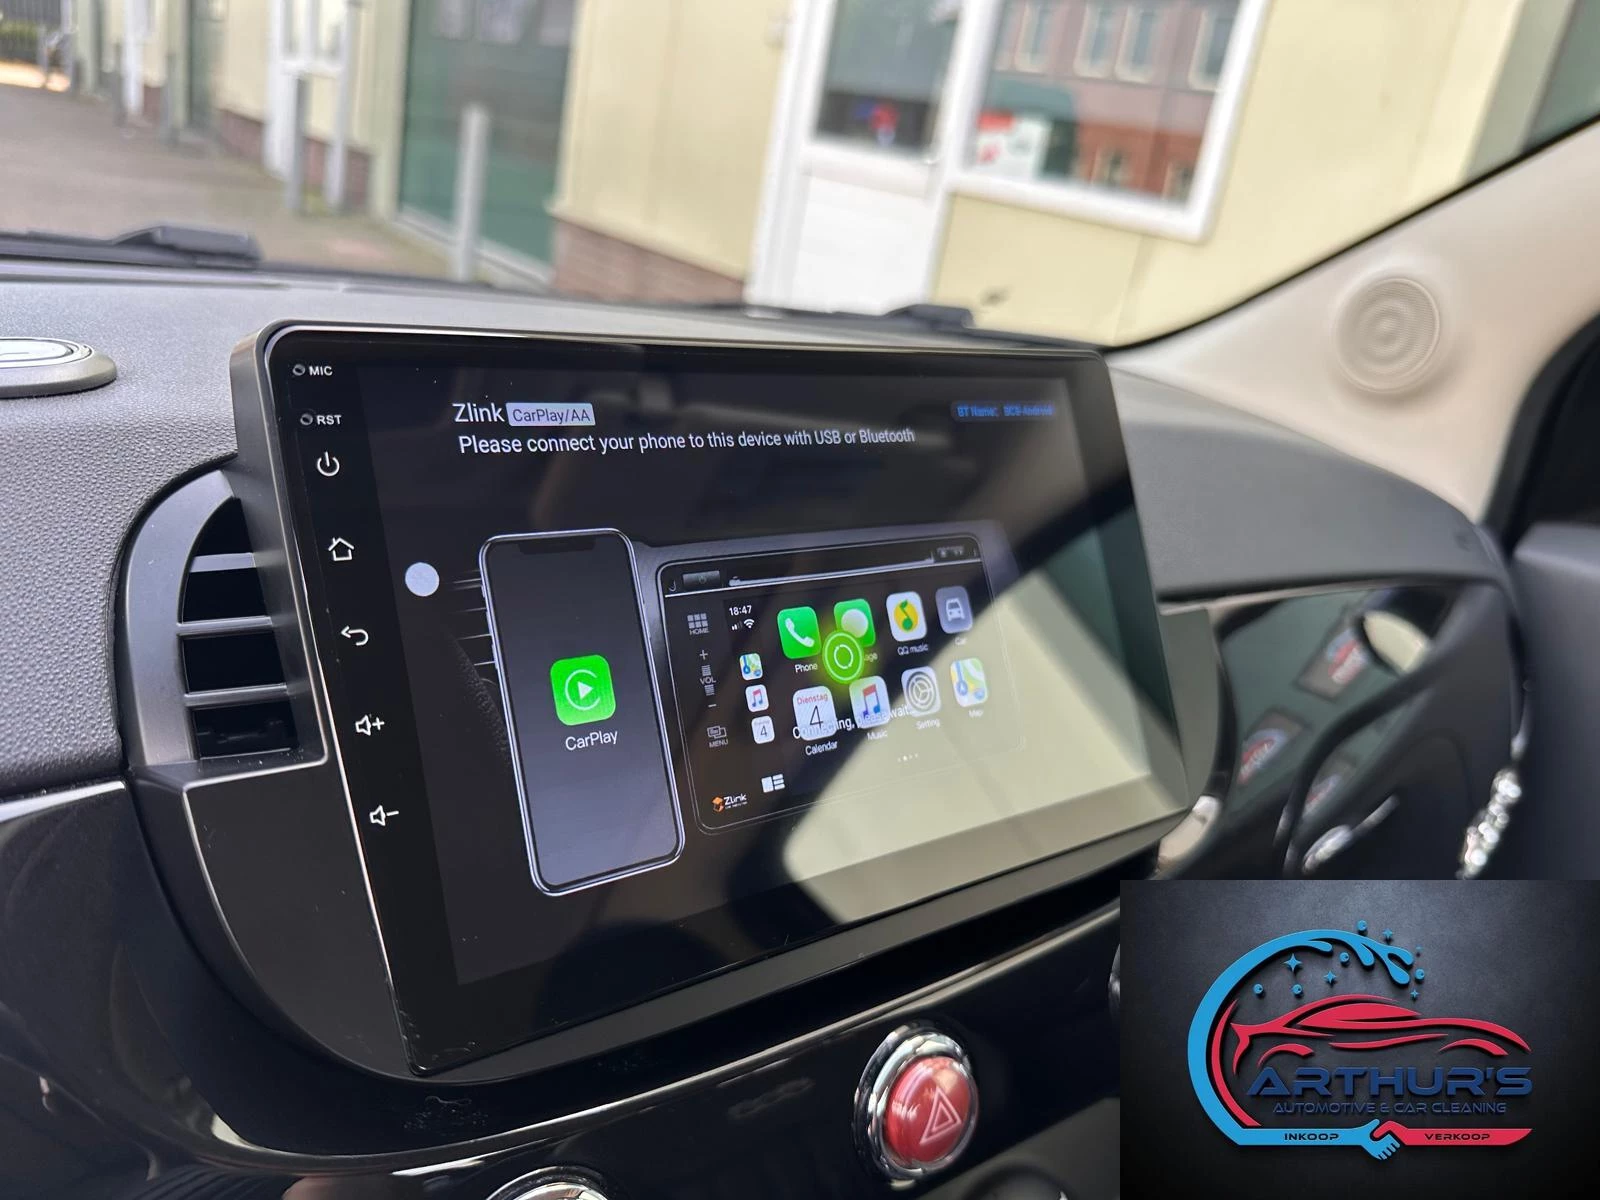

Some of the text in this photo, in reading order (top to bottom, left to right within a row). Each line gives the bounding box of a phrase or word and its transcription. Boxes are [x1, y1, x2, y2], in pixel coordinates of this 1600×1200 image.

[308, 366, 333, 377] MIC
[316, 414, 343, 426] RST
[452, 403, 592, 425] Zlink CarPlay/AA
[459, 427, 916, 455] Please connect your phone to this device with USB or Bluetooth
[729, 605, 752, 616] 18:47
[689, 628, 710, 636] HOME
[794, 663, 818, 673] Phone
[700, 677, 717, 685] VOL
[796, 692, 829, 705] Dienstag
[809, 705, 824, 729] 4
[760, 725, 768, 736] 4
[867, 729, 888, 741] Music
[565, 730, 618, 751] CarPlay
[709, 739, 728, 748] MENU
[805, 740, 838, 755] Calendar
